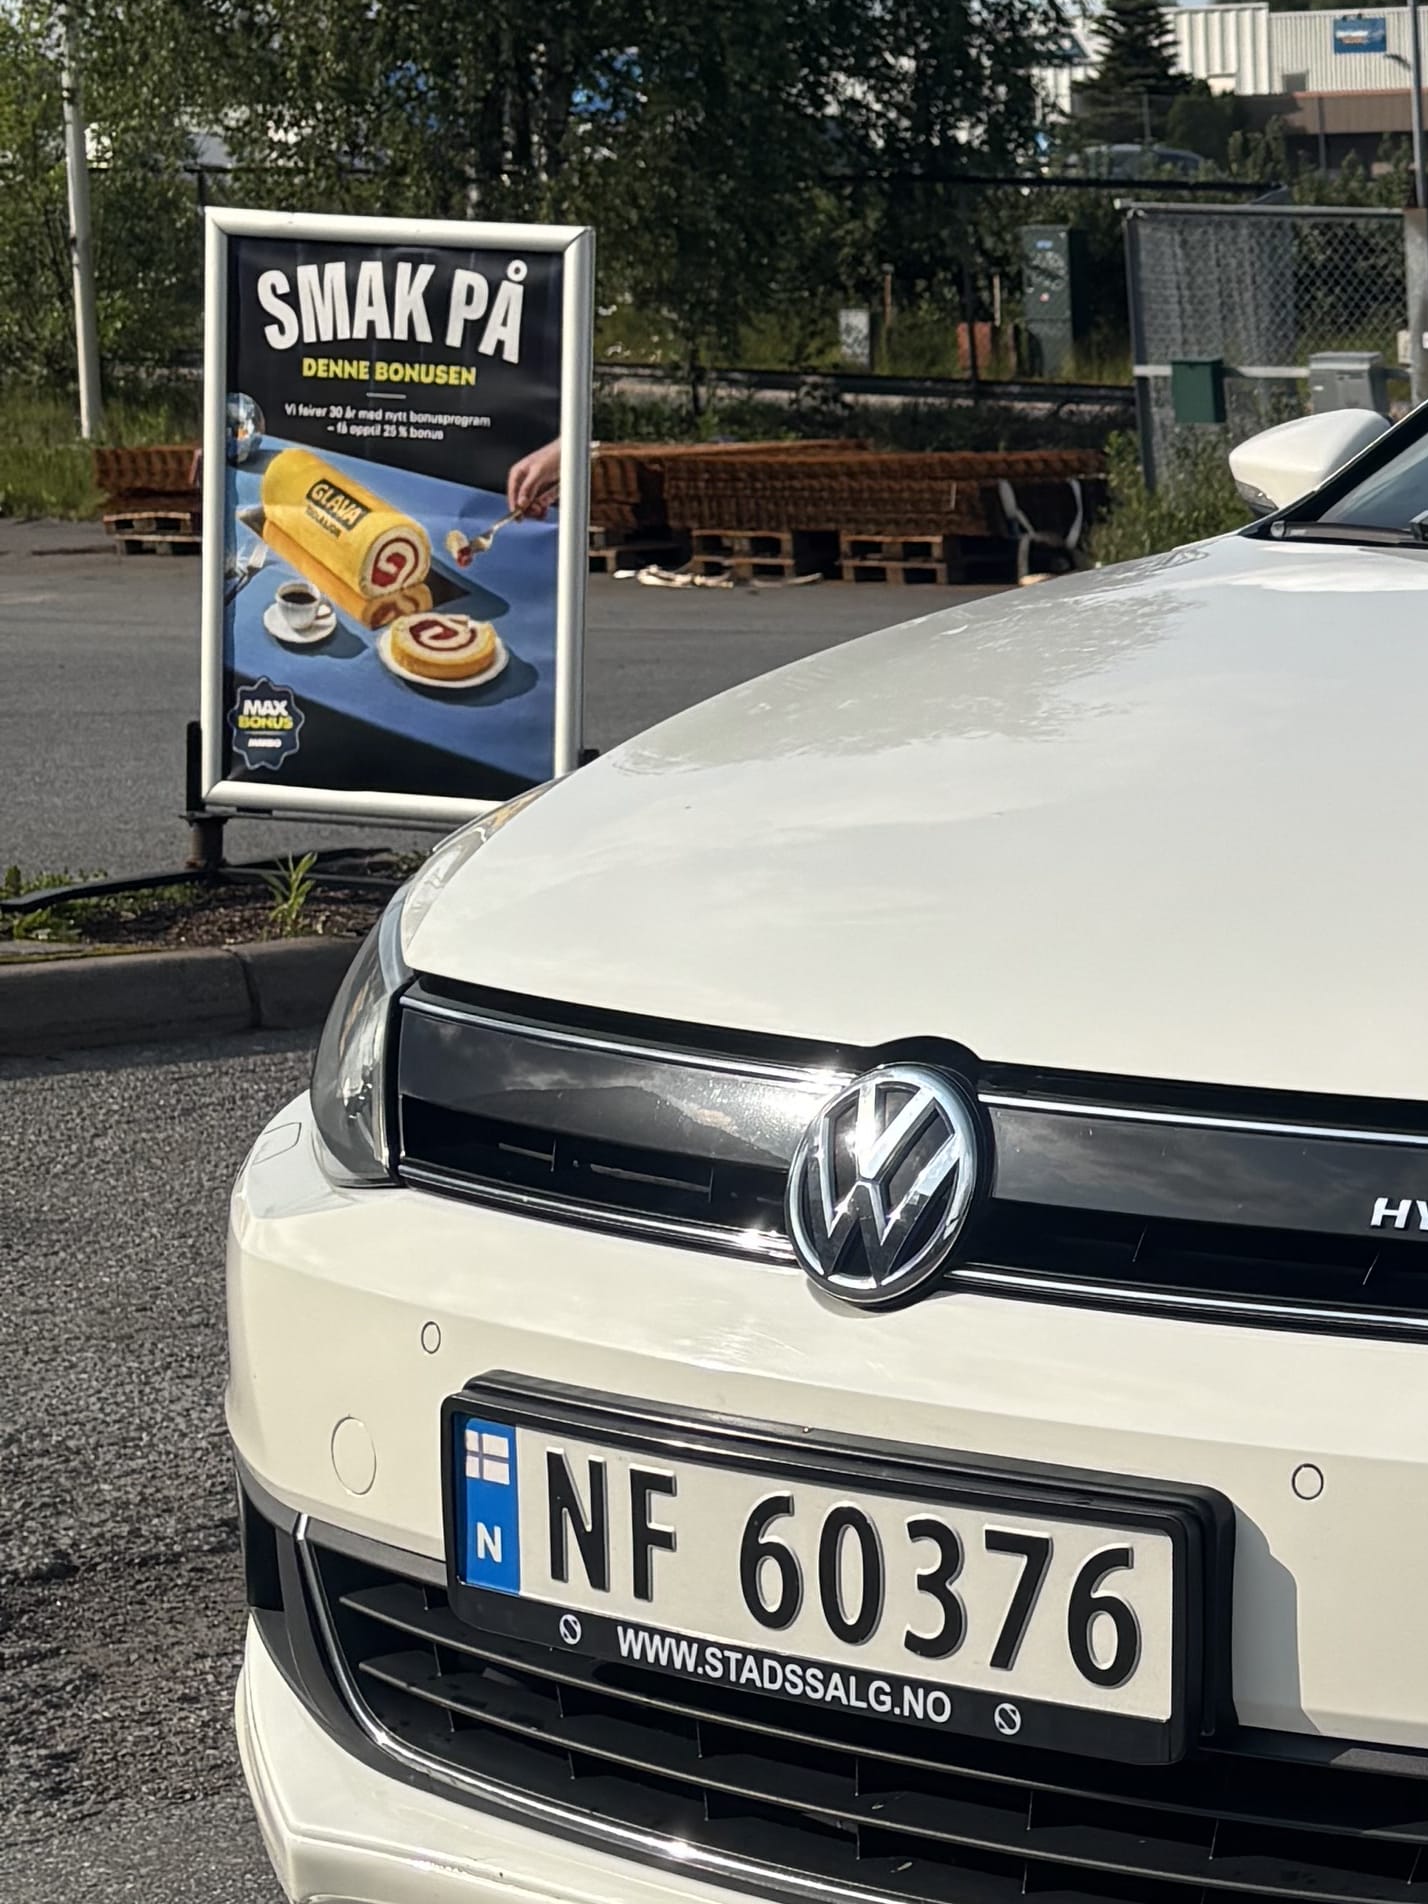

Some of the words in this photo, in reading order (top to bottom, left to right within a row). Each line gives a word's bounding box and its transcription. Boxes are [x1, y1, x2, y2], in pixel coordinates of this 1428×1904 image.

[256, 260, 436, 350] SMAK
[445, 258, 528, 364] PÅ
[302, 357, 370, 381] DENNE
[374, 361, 477, 386] BONUSEN
[284, 403, 297, 417] Vi
[299, 403, 327, 418] feirer
[329, 405, 343, 419] 30
[344, 406, 355, 420] år
[358, 408, 383, 421] med
[409, 410, 492, 429] bonusprogram
[383, 424, 397, 438] 25
[409, 426, 444, 440] bonus
[311, 483, 363, 525] GLAVA
[238, 715, 294, 729] BONUS
[243, 699, 289, 716] MAX
[476, 1521, 502, 1563] N
[546, 1446, 678, 1602] NF
[740, 1490, 1142, 1690] 60376
[617, 1625, 952, 1724] WWW.STADSSALG.NO
